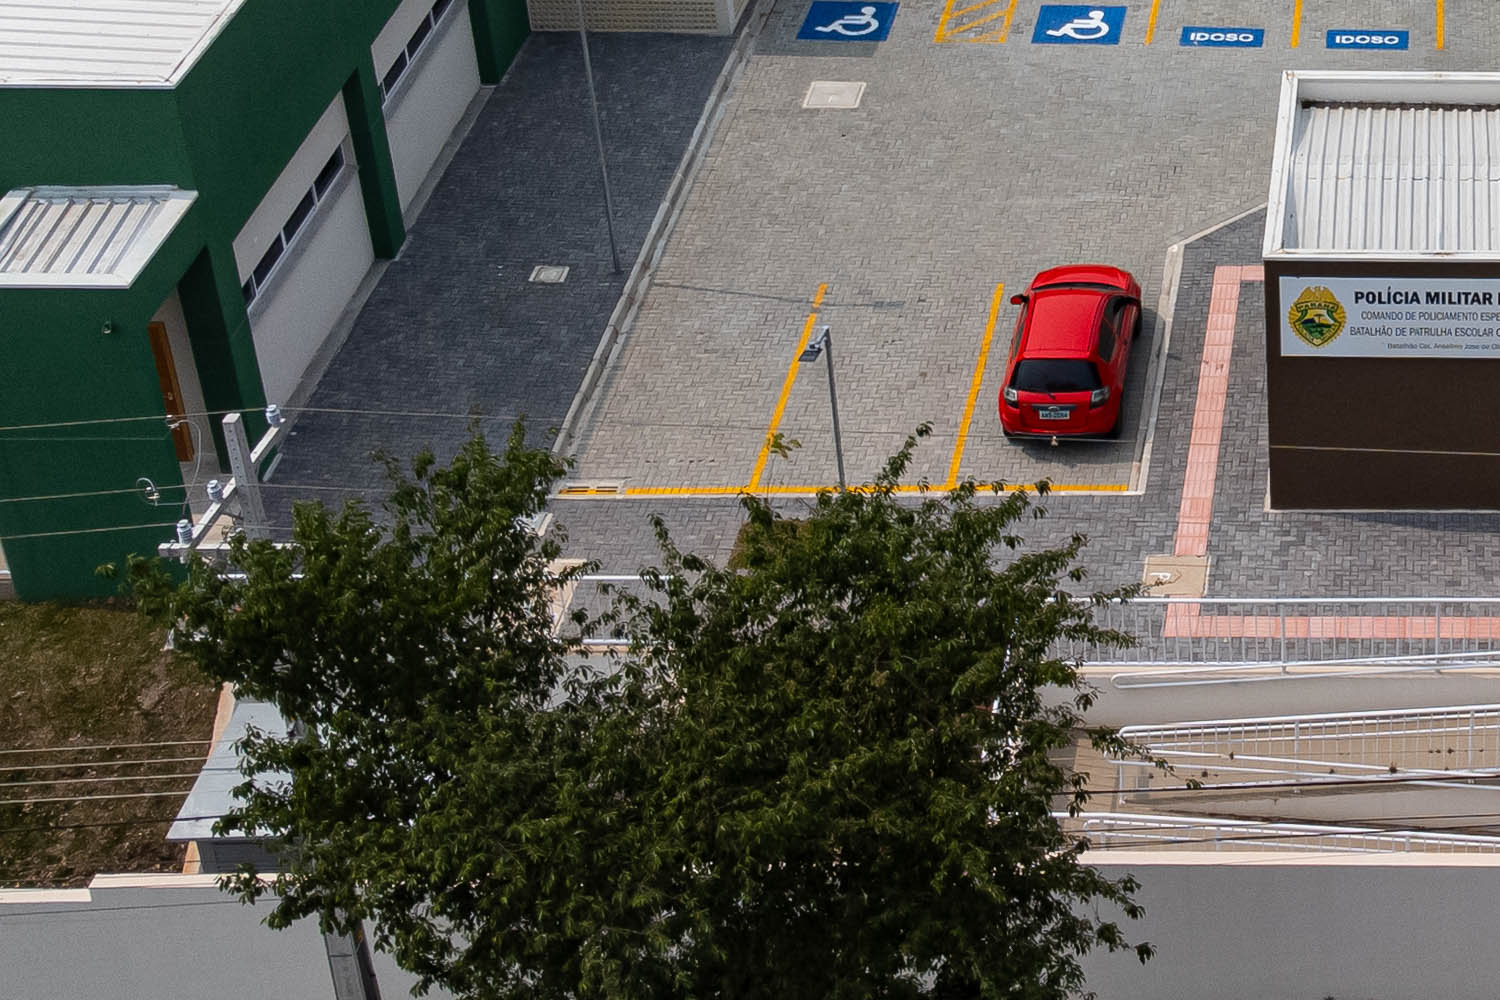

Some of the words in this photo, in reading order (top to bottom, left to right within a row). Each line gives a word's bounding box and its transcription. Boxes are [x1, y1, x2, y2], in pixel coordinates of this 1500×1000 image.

[1189, 32, 1254, 42] IDOSO
[1335, 35, 1399, 44] IDOSO
[1353, 285, 1422, 305] POLÍCIA
[1424, 290, 1494, 306] MILITAR
[1360, 311, 1402, 321] COMANDO
[1404, 311, 1416, 321] DE
[1418, 311, 1479, 321] POLICIAMENTO
[1349, 325, 1394, 337] BATALHÃO
[1395, 326, 1407, 337] DE
[1408, 326, 1453, 337] PATRULHA
[1454, 326, 1494, 337] ESCOLAR
